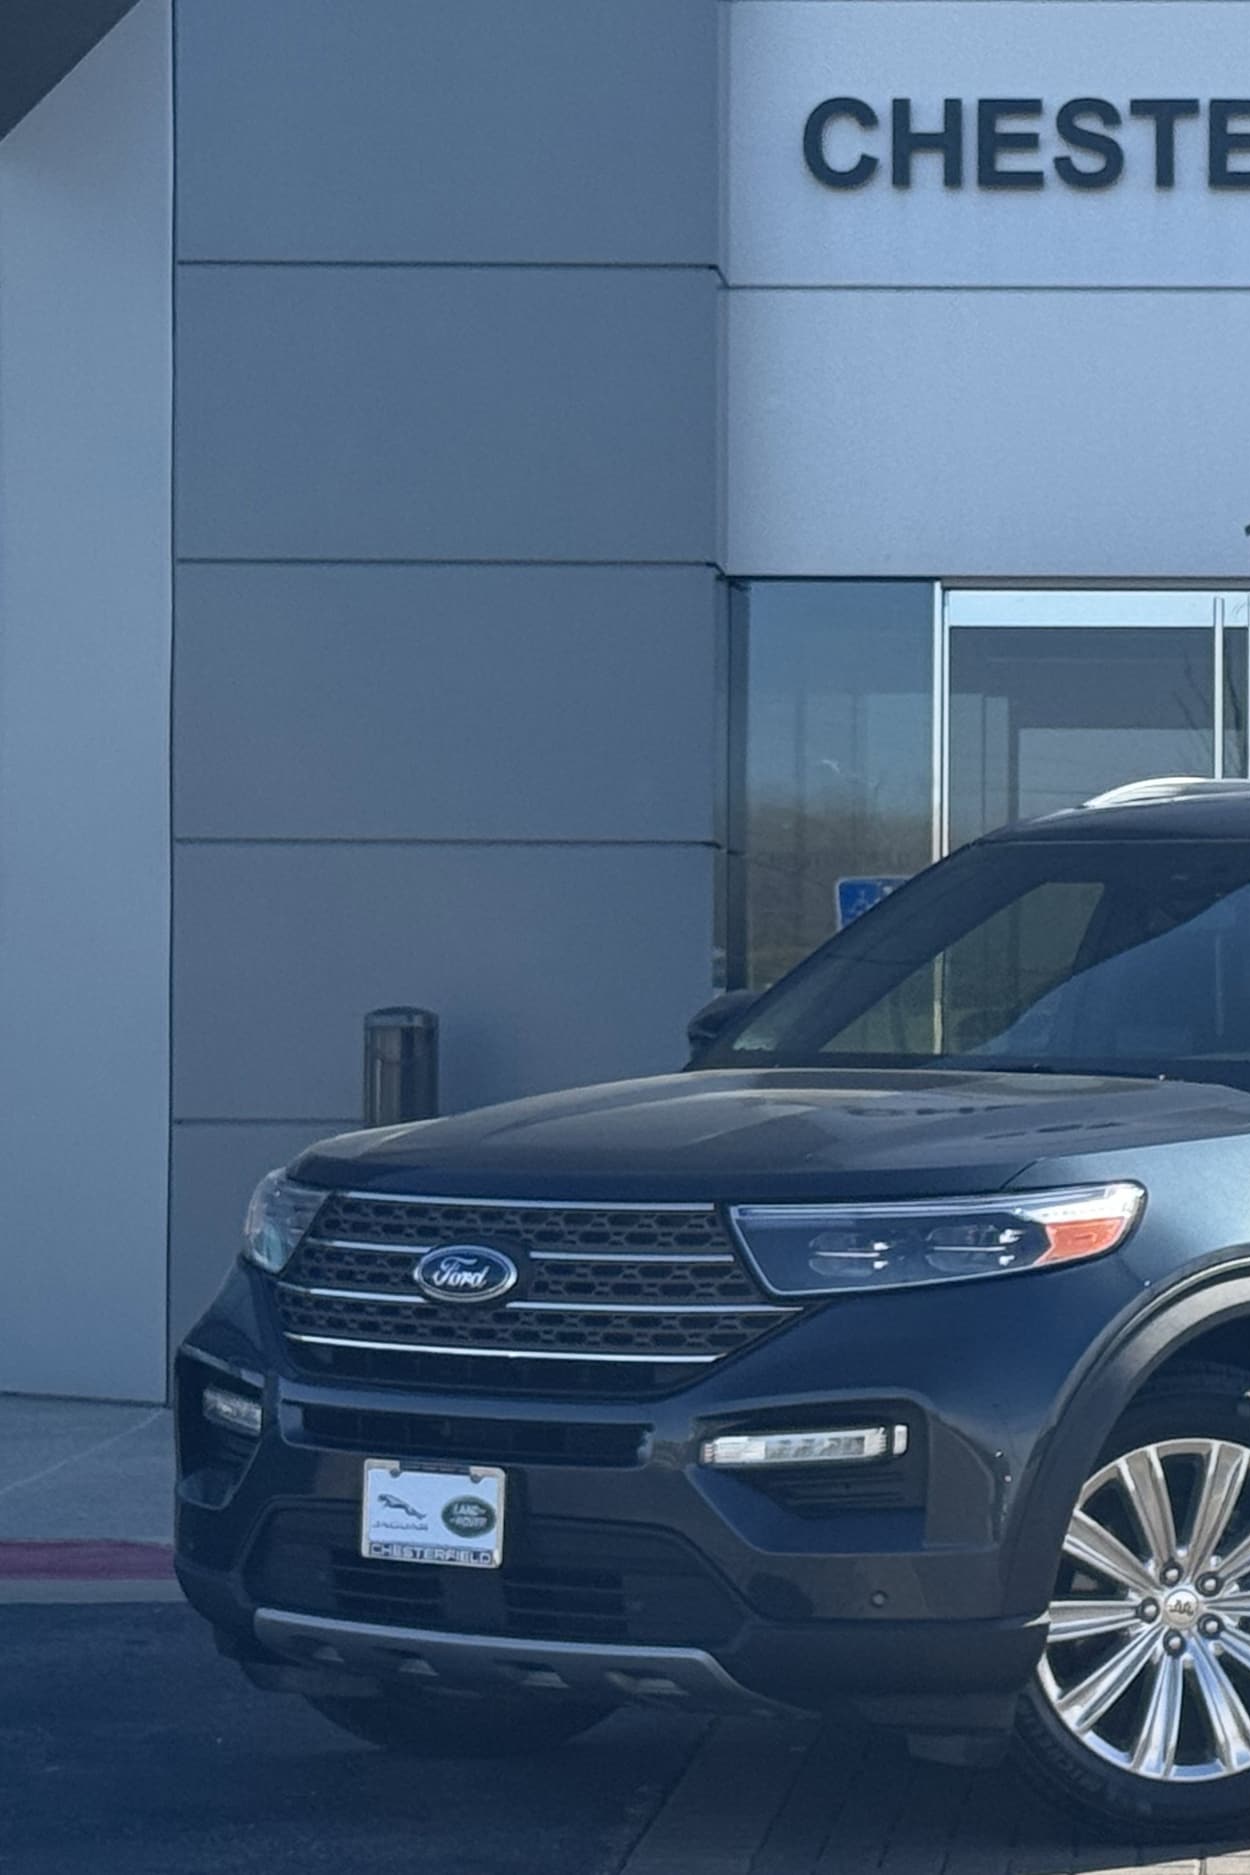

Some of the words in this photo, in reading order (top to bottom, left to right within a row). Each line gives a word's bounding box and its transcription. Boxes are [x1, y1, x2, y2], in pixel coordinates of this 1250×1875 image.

[432, 1256, 490, 1288] Ford
[373, 1520, 428, 1531] JAGUAR
[371, 1543, 492, 1565] CHESTERFIELD
